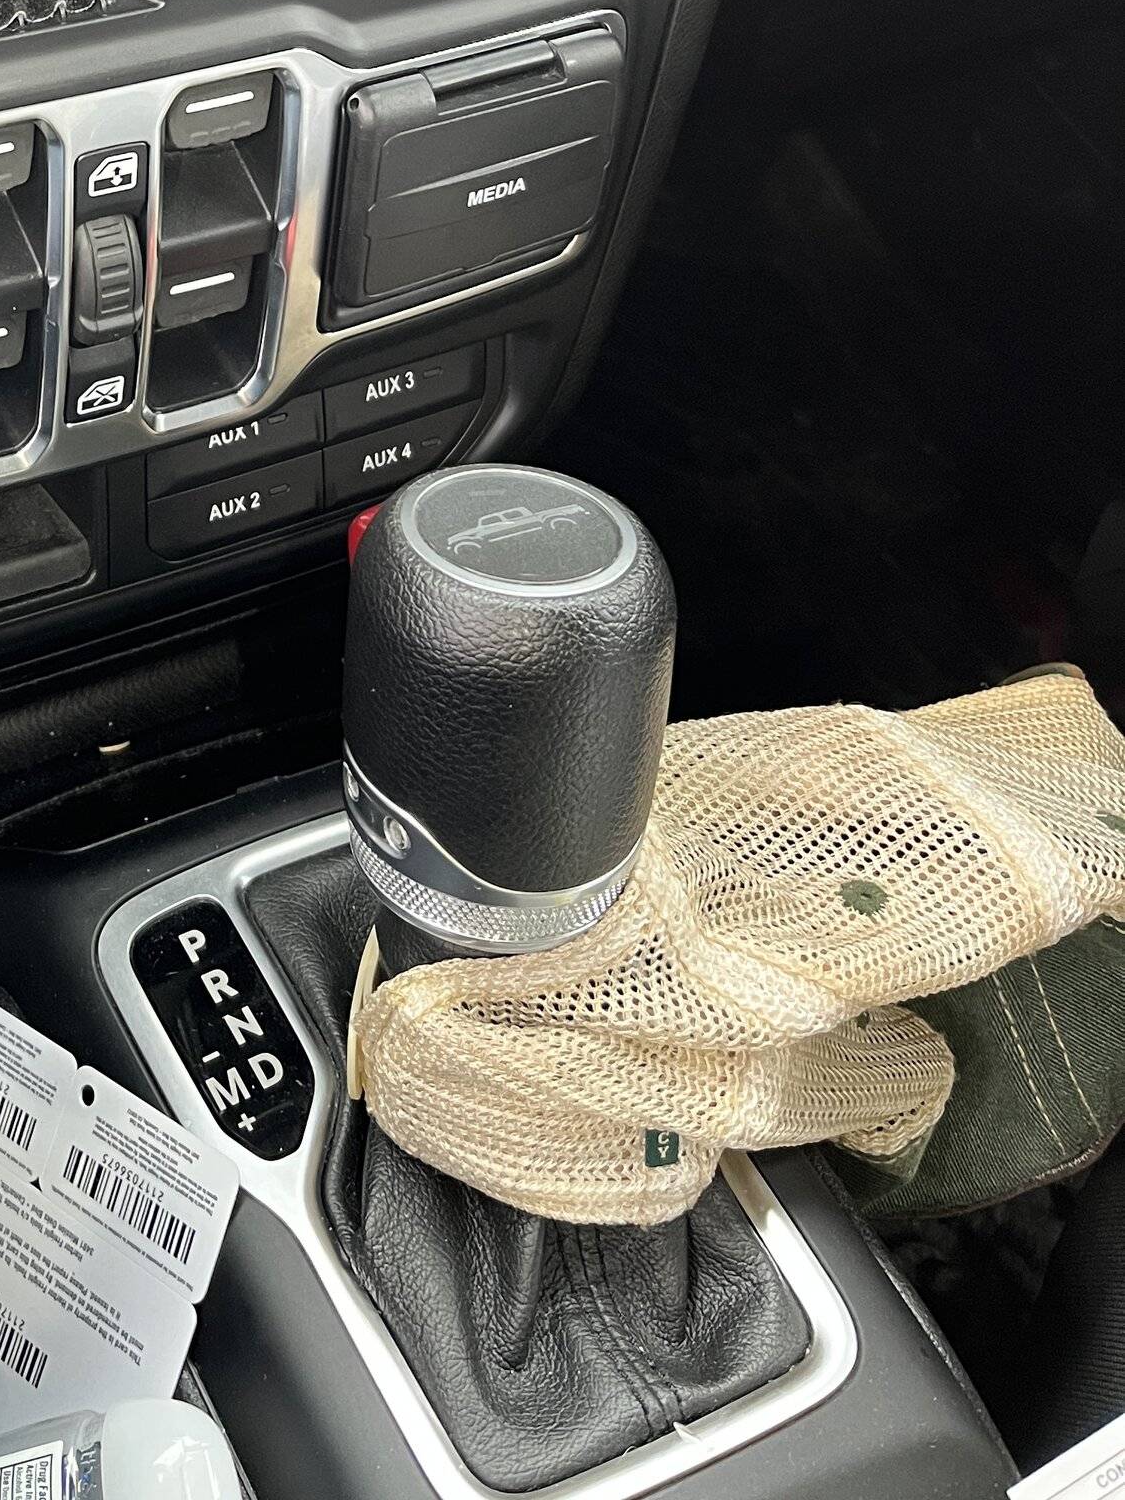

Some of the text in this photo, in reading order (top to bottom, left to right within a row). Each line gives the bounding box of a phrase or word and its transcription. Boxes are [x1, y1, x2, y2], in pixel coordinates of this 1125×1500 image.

[467, 176, 526, 208] MEDIA
[365, 371, 415, 402] AUX 3
[208, 420, 260, 449] AUX 1
[362, 442, 412, 473] AUX 4
[208, 492, 261, 522] AUX 2
[178, 929, 206, 964] P
[200, 968, 239, 1004] R
[222, 1005, 264, 1045] N
[205, 1052, 284, 1112] M D
[101, 1153, 165, 1203] 2117036675
